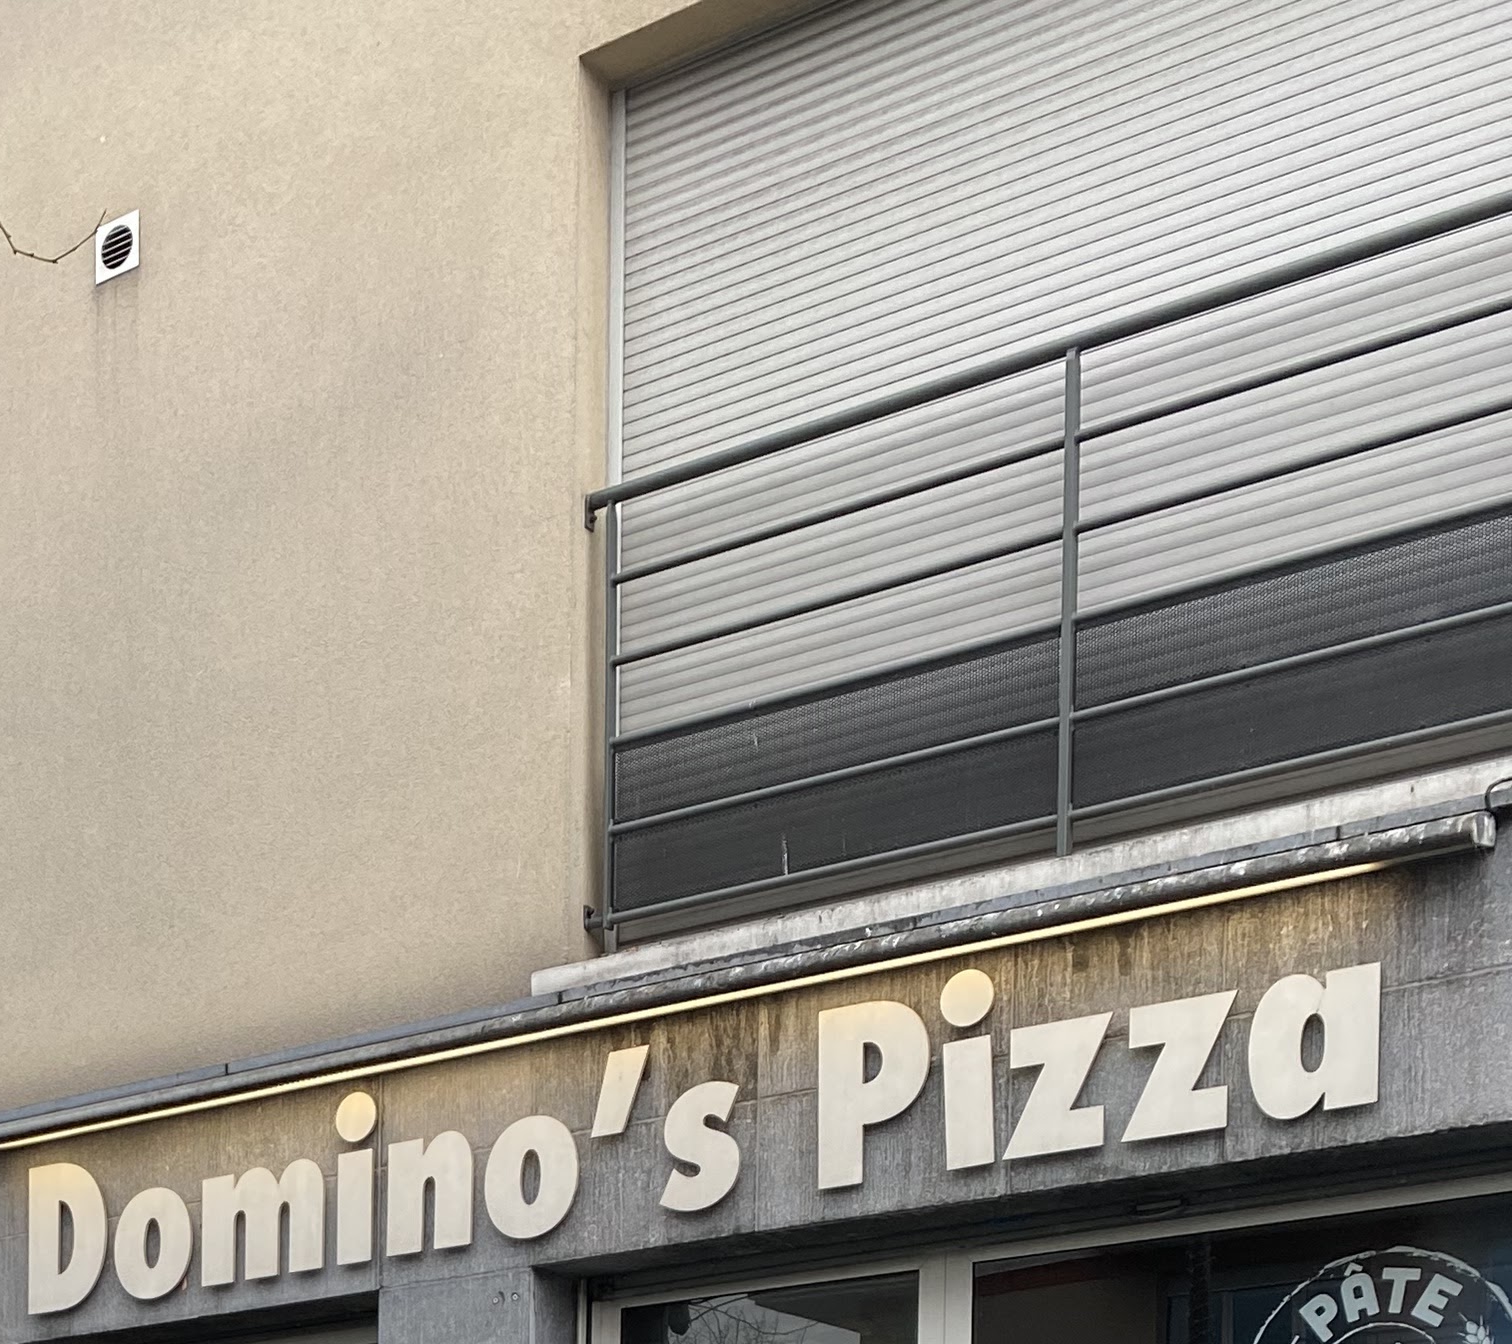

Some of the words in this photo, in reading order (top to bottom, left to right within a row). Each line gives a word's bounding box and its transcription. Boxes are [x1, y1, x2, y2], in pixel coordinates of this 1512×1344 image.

[28, 1045, 740, 1315] Domino's
[818, 962, 1381, 1190] Pizza
[1299, 1263, 1463, 1343] PÂTE
